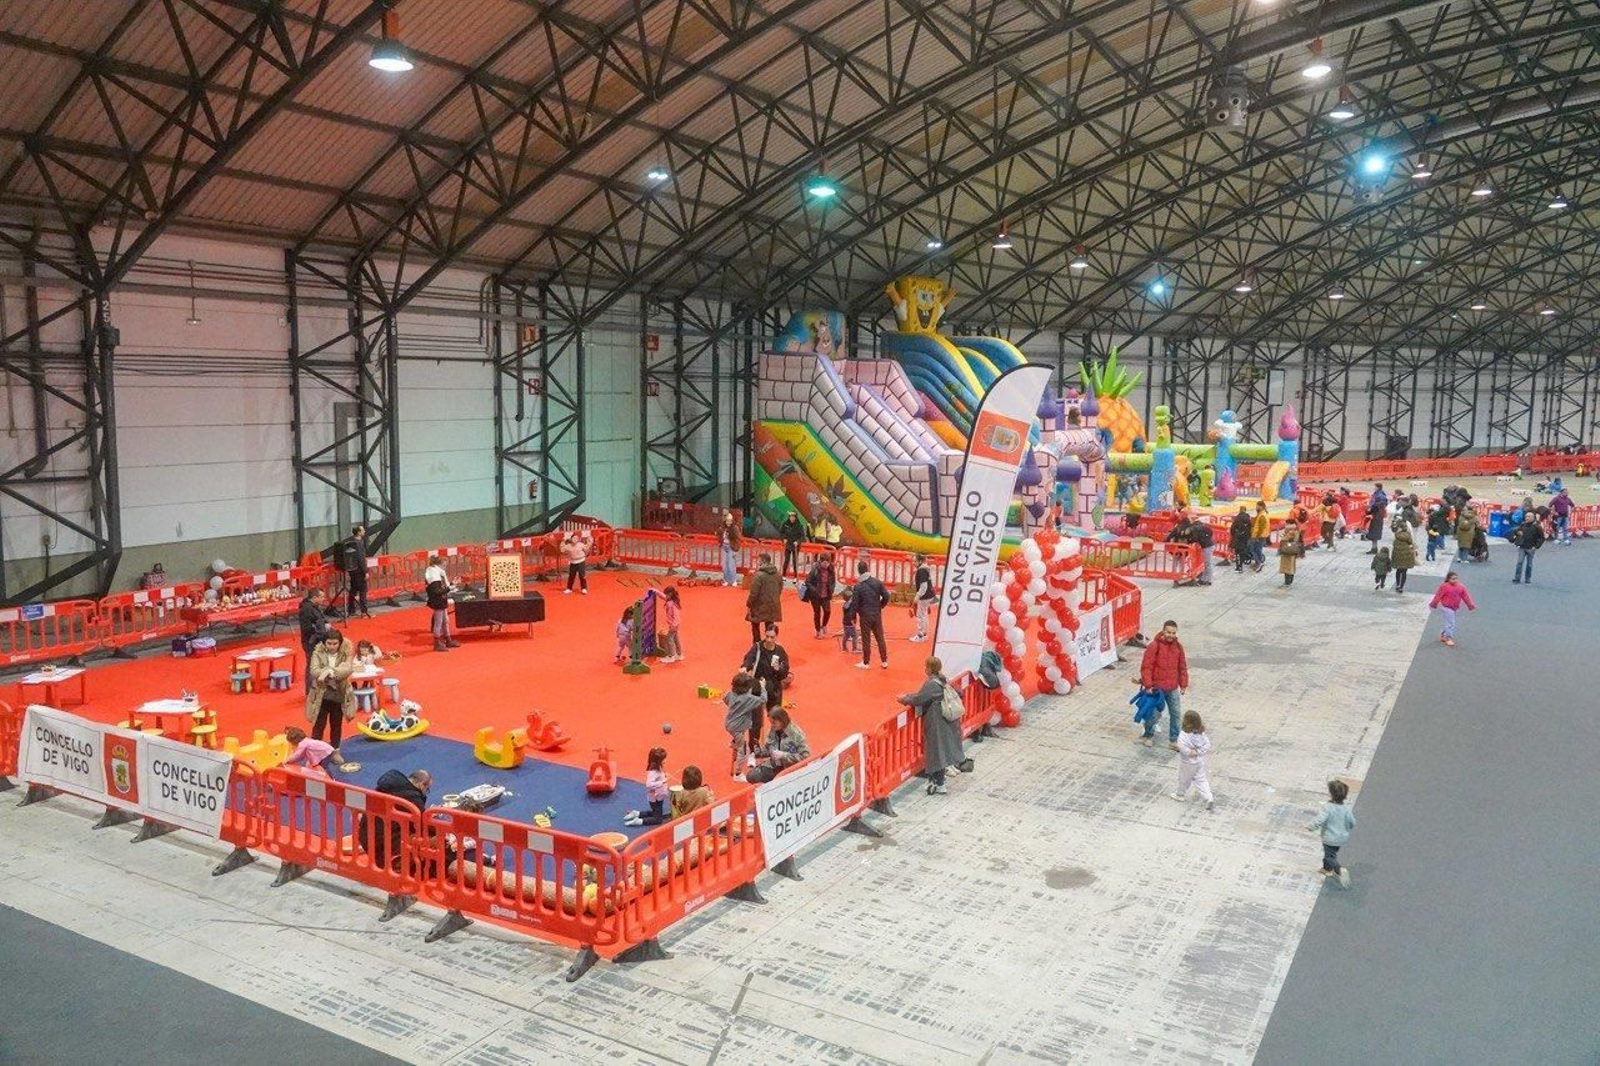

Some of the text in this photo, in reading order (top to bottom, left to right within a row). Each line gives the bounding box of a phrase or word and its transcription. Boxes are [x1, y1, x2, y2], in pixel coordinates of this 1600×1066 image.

[947, 491, 981, 616] CONCELLO
[966, 511, 999, 603] DE VIGO
[35, 726, 93, 758] CONCELLO
[43, 748, 89, 774] DE VIGO
[153, 760, 225, 792] CONCELLO
[162, 783, 216, 811] DE VIGO
[767, 776, 829, 821] CONCELLO
[775, 801, 821, 839] DE VIGO
